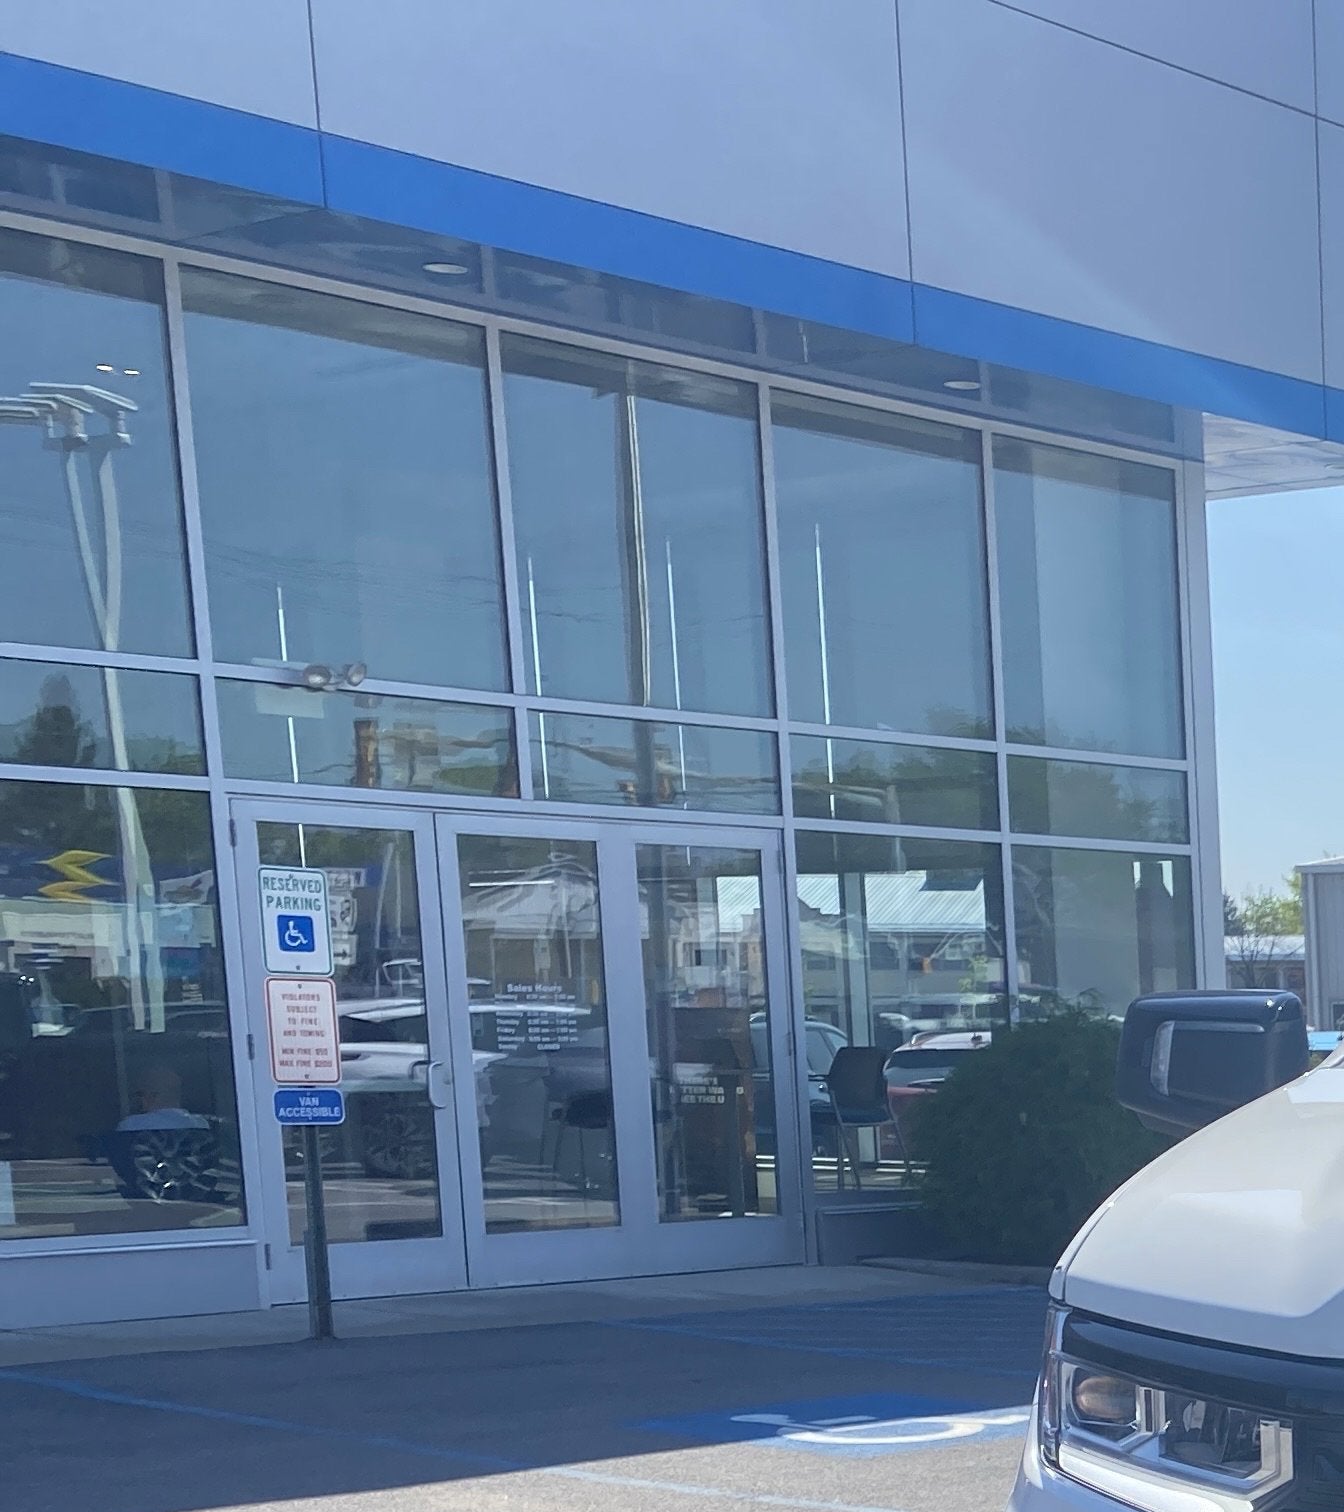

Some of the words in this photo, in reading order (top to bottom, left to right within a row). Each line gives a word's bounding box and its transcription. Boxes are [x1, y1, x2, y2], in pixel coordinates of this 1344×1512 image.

[262, 876, 322, 894] RESERVED
[266, 895, 322, 912] PARKING
[507, 984, 533, 993] Sales
[535, 984, 562, 993] Hours
[299, 1096, 320, 1107] VAN
[278, 1107, 341, 1118] ACCESSIBLE
